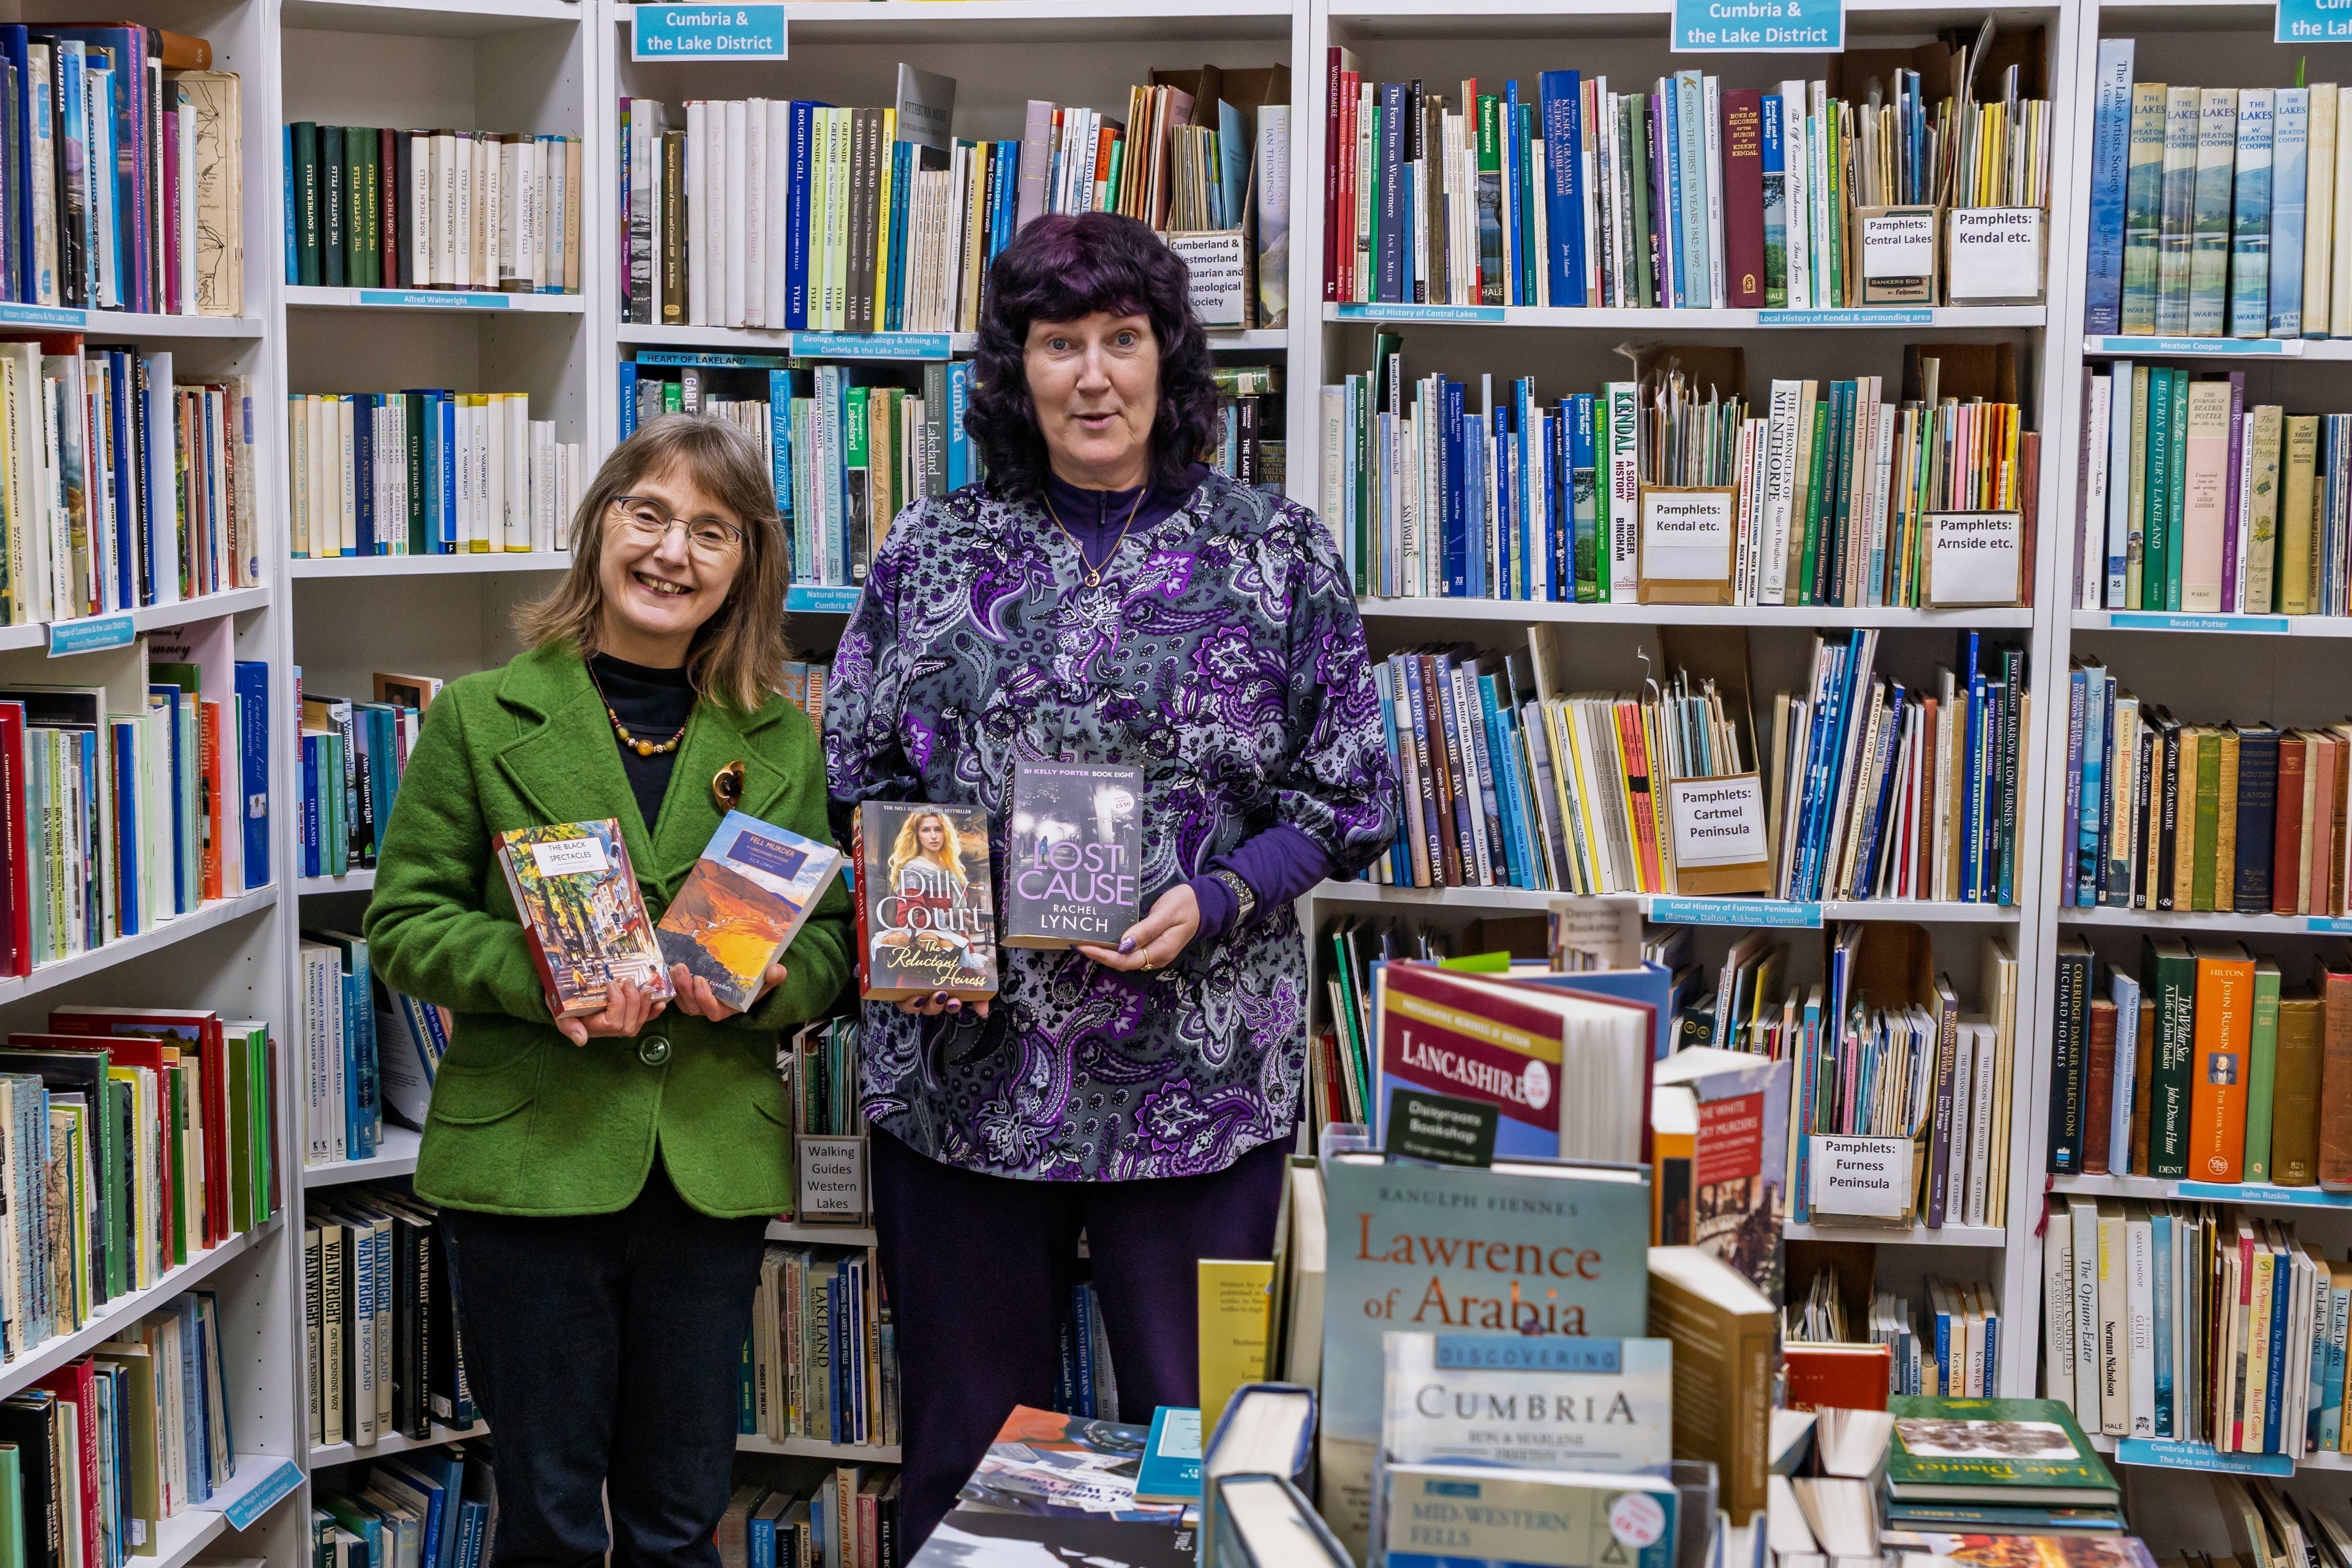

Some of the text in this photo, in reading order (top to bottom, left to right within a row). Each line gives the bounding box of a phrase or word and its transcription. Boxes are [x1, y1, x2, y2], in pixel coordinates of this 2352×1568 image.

[1710, 2, 1801, 17] Cumbria &
[666, 12, 748, 26] Cumbria &
[2292, 20, 2322, 36] the
[1688, 27, 1827, 43] the Lake District
[647, 36, 772, 50] the Lake District
[1389, 107, 1398, 129] Ferry
[2241, 111, 2272, 120] LAKES
[1390, 150, 1394, 161] on
[1388, 164, 1396, 217] Windermere
[1871, 221, 1926, 231] Pamphlets:
[1961, 213, 2031, 227] Pamphlets:
[1865, 235, 1931, 244] Central Lakes
[1961, 232, 2030, 243] Kendal etc.
[1171, 239, 1228, 251] Cumberland
[404, 295, 467, 306] Alfred Wainwright
[1189, 298, 1223, 308] Society
[1363, 309, 1384, 318] Local
[1387, 309, 1414, 318] History
[1862, 314, 1910, 322] surrounding
[803, 335, 834, 344] Geology,
[837, 336, 895, 345] Geomorphology
[2193, 342, 2223, 352] Cooper
[695, 356, 747, 365] LAKELAND
[1615, 391, 1635, 456] KENDAL
[1657, 505, 1720, 516] Pamphlets:
[1657, 521, 1695, 530] Kendal
[1941, 519, 2011, 532] Pamphlets:
[1938, 538, 2013, 548] Arnside etc.
[2200, 620, 2228, 628] Potter
[1683, 790, 1751, 804] Pamphlets:
[1694, 806, 1742, 820] Cartmel
[1691, 824, 1749, 837] Peninsula
[750, 836, 795, 858] FELL MURDER
[550, 851, 592, 862] SPECTACLES
[1033, 841, 1123, 873] LOST
[760, 861, 775, 870] LORAC
[899, 869, 970, 908] Dilly
[1017, 870, 1135, 906] CAUSE
[876, 896, 986, 932] Court
[1054, 904, 1097, 915] RACHEL
[1041, 914, 1108, 933] LYNCH
[1665, 912, 1807, 925] (Barrow, Dalton, Askham, Ulverston)
[919, 938, 941, 952] The
[887, 946, 960, 968] Reluctant
[933, 966, 987, 987] Heiress
[2221, 979, 2233, 1049] JOHN RUSKIN
[1401, 1030, 1528, 1105] LANCASHIRE
[809, 1147, 854, 1159] Walking
[1826, 1141, 1895, 1155] Pamphlets:
[812, 1164, 851, 1174] Guides
[1837, 1159, 1883, 1170] Furness
[807, 1181, 856, 1191] Western
[1830, 1177, 1889, 1188] Peninsula
[2241, 1190, 2290, 1200] John Ruskin
[818, 1198, 848, 1208] Lakes
[1379, 1187, 1579, 1218] RANULPH FIENNES
[1355, 1213, 1602, 1281] Lawrence
[358, 1237, 374, 1321] WAINWRIGHT
[1363, 1276, 1589, 1337] of Arabia
[2080, 1260, 2094, 1363] The Opium-Eater
[363, 1324, 370, 1334] IN
[816, 1286, 829, 1367] LAKELAND
[1439, 1348, 1618, 1369] DISCOVERING
[1415, 1383, 1638, 1425] CUMBRIA
[2150, 1444, 2185, 1453] Cumbria
[2212, 1460, 2252, 1470] Literature
[1411, 1501, 1571, 1531] MID-WESTERN
[1410, 1527, 1472, 1548] FELLS
